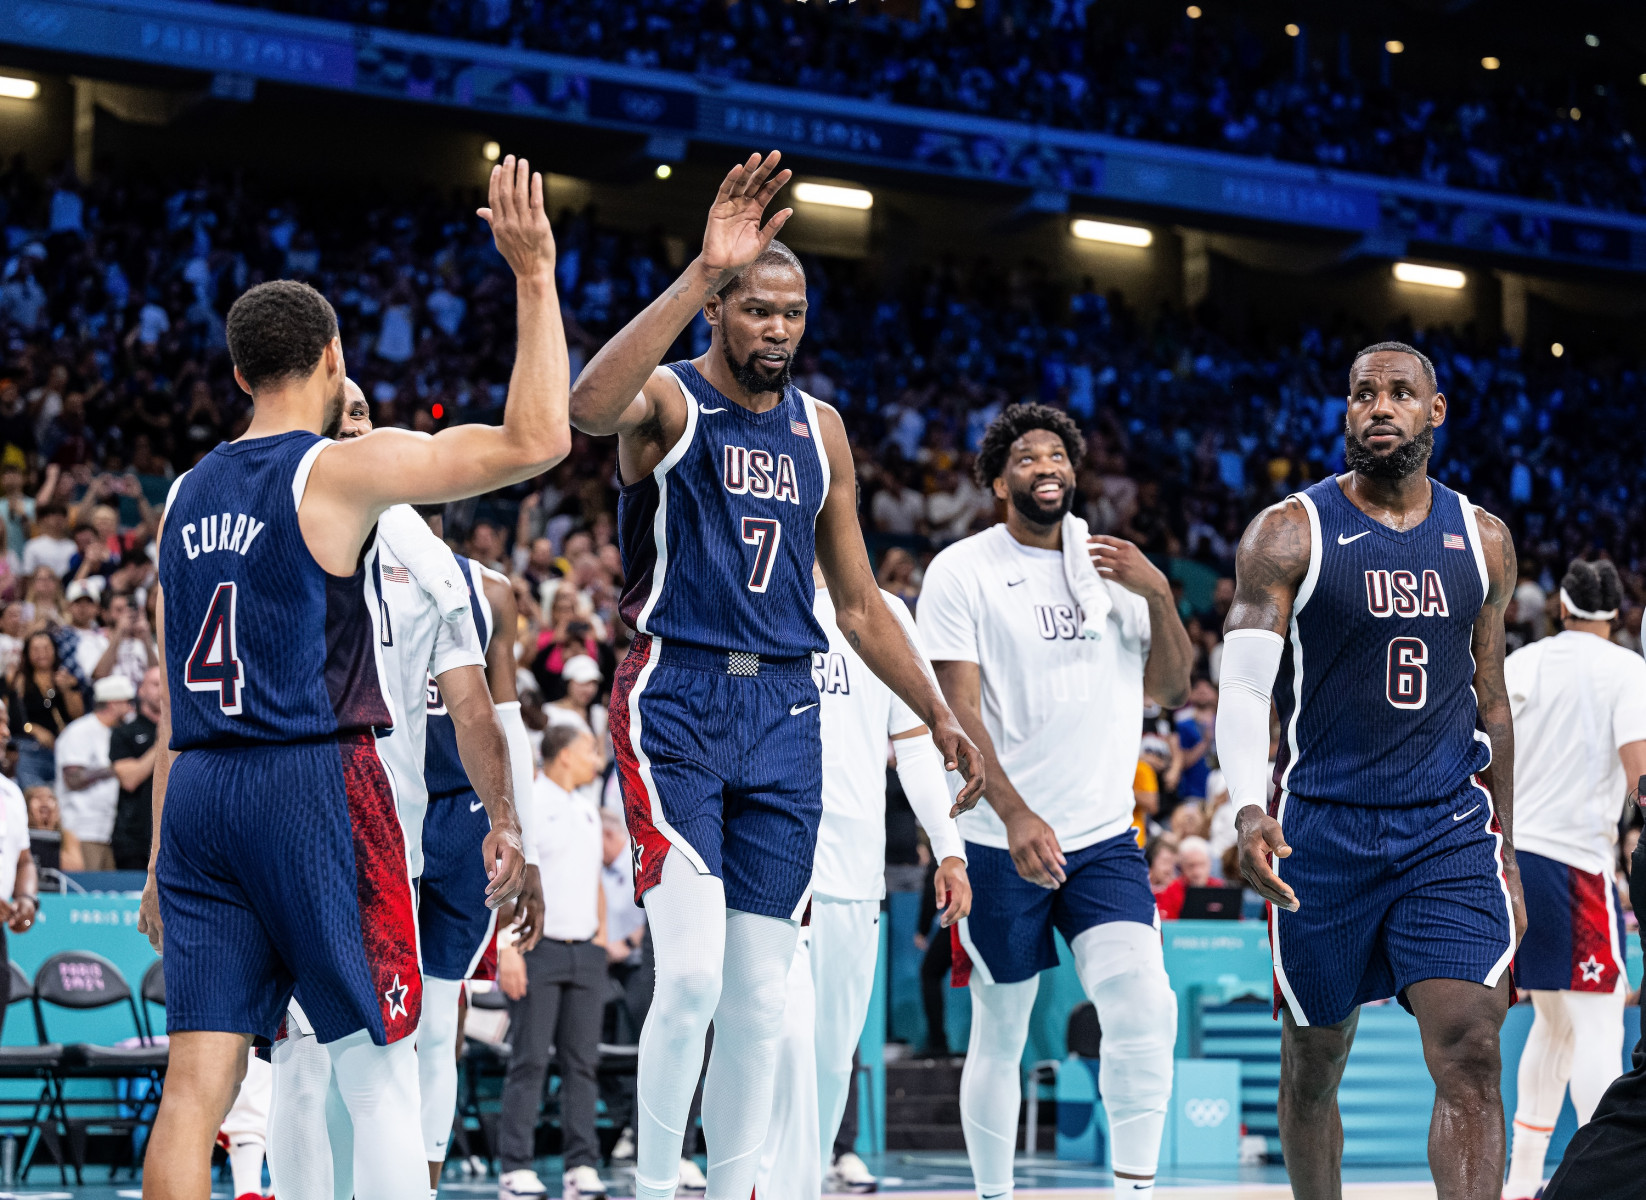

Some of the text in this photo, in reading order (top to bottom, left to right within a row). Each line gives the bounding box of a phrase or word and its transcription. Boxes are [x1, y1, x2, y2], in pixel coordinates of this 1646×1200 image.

[724, 444, 800, 505] USA
[181, 512, 265, 560] CURRY
[741, 516, 781, 594] 7
[1364, 569, 1450, 618] USA
[184, 581, 245, 716] 4
[1386, 636, 1429, 710] 6
